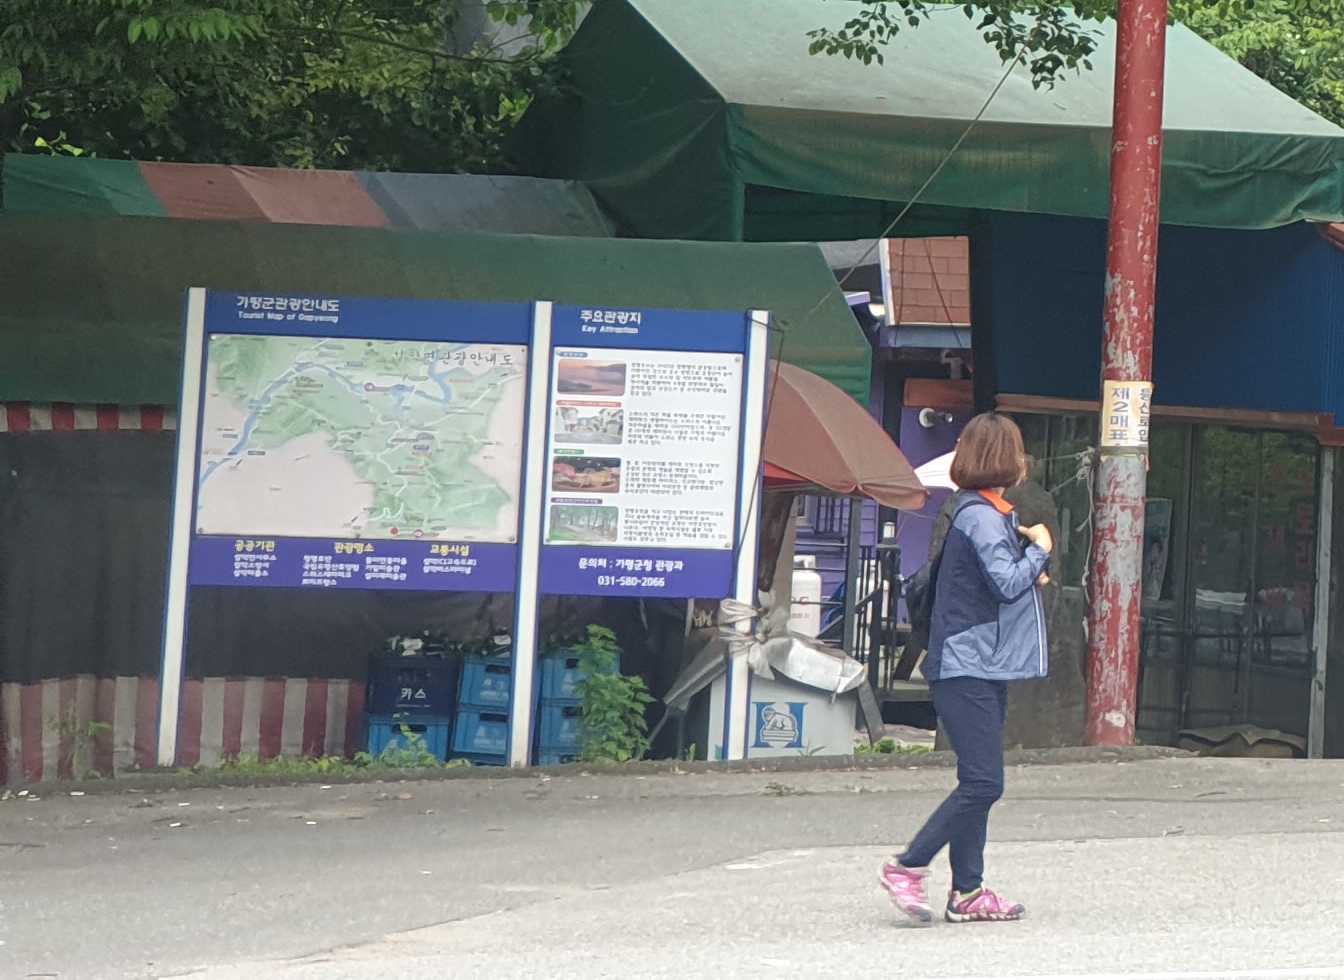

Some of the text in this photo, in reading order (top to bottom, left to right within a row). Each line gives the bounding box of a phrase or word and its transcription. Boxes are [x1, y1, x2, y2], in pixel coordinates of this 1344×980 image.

[237, 296, 340, 312] 가평군관광안내도
[580, 310, 641, 325] 주요관광지
[1109, 388, 1130, 446] 제2매표
[598, 575, 665, 587] 031-580-2066
[401, 688, 426, 700] 카스
